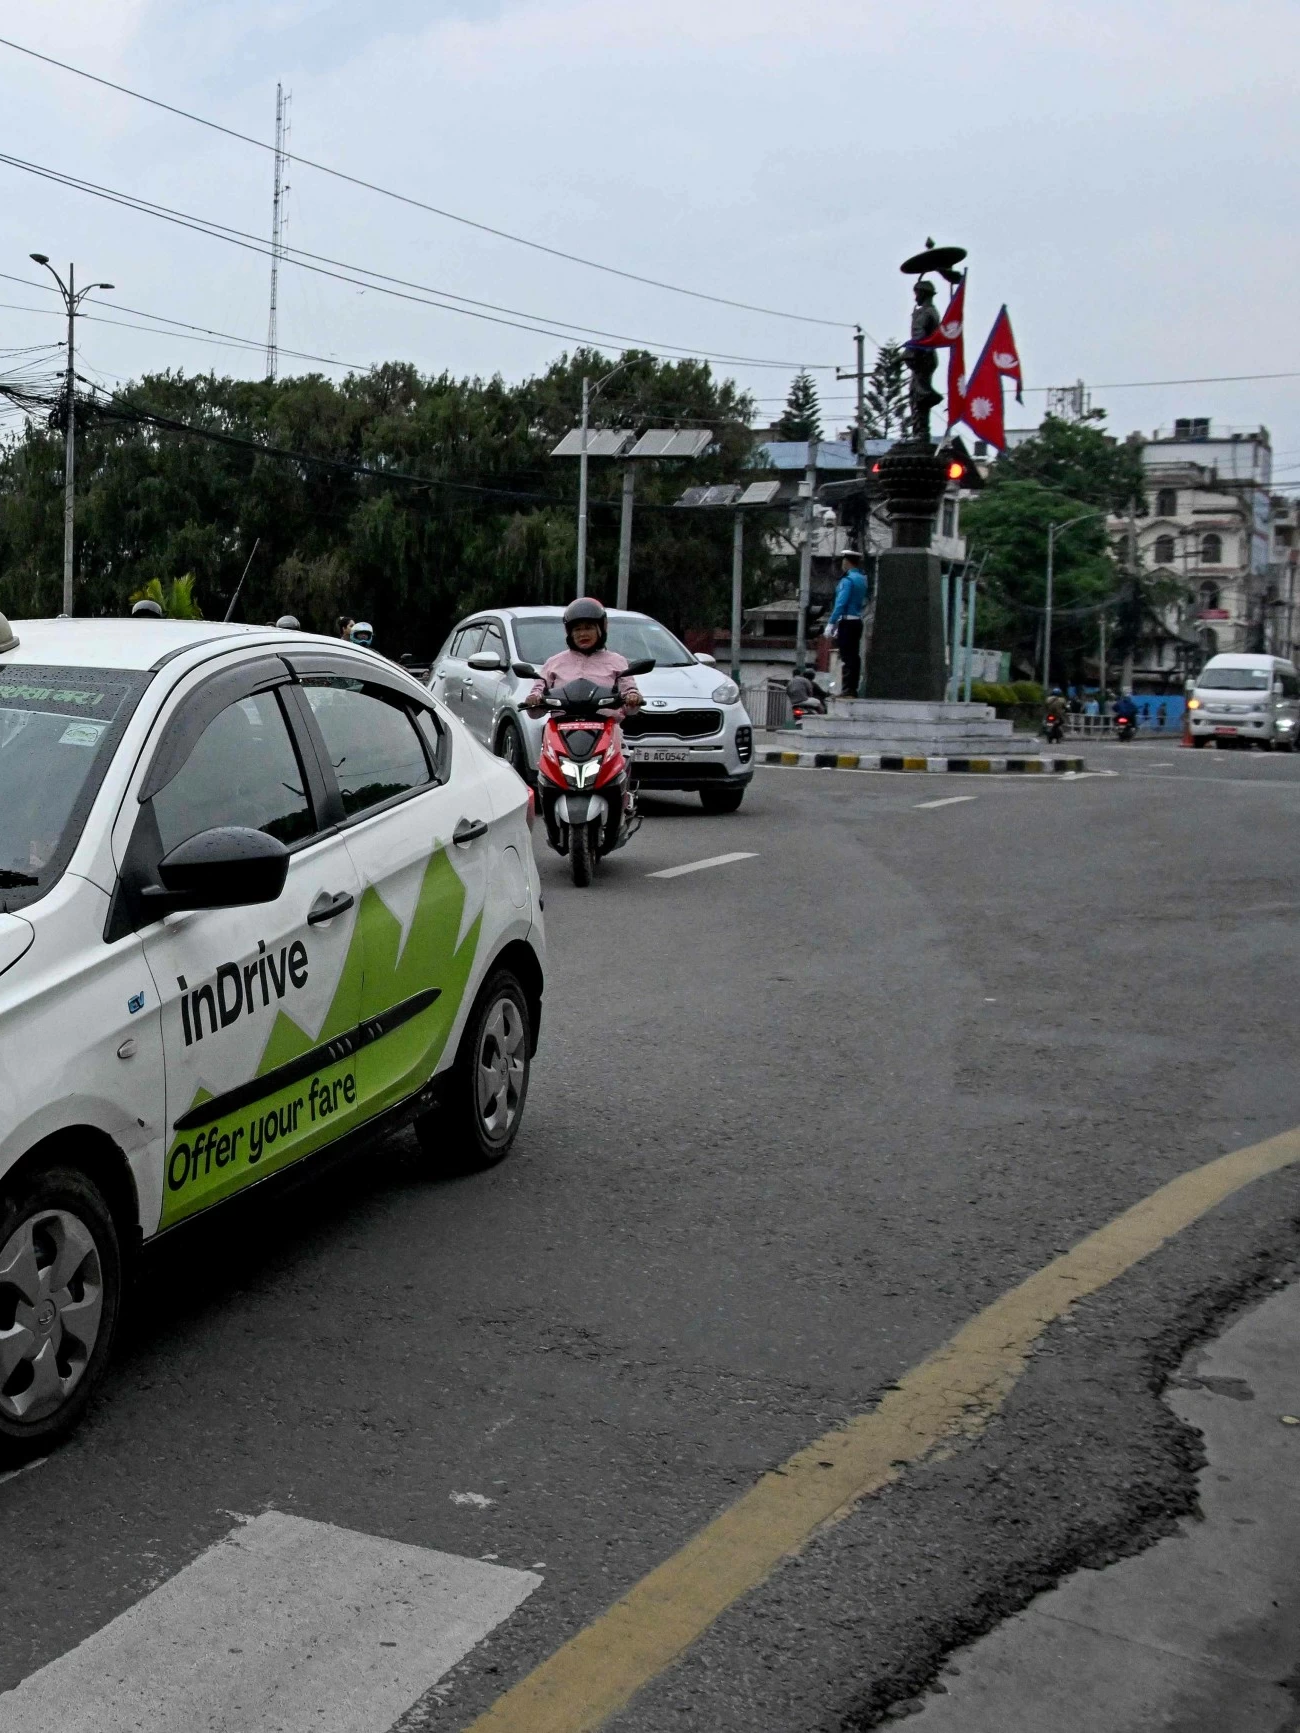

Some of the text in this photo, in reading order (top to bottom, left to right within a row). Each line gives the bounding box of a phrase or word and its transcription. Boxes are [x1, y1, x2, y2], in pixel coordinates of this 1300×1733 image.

[177, 939, 309, 1047] inDrive
[168, 1073, 356, 1191] Offer your fare
